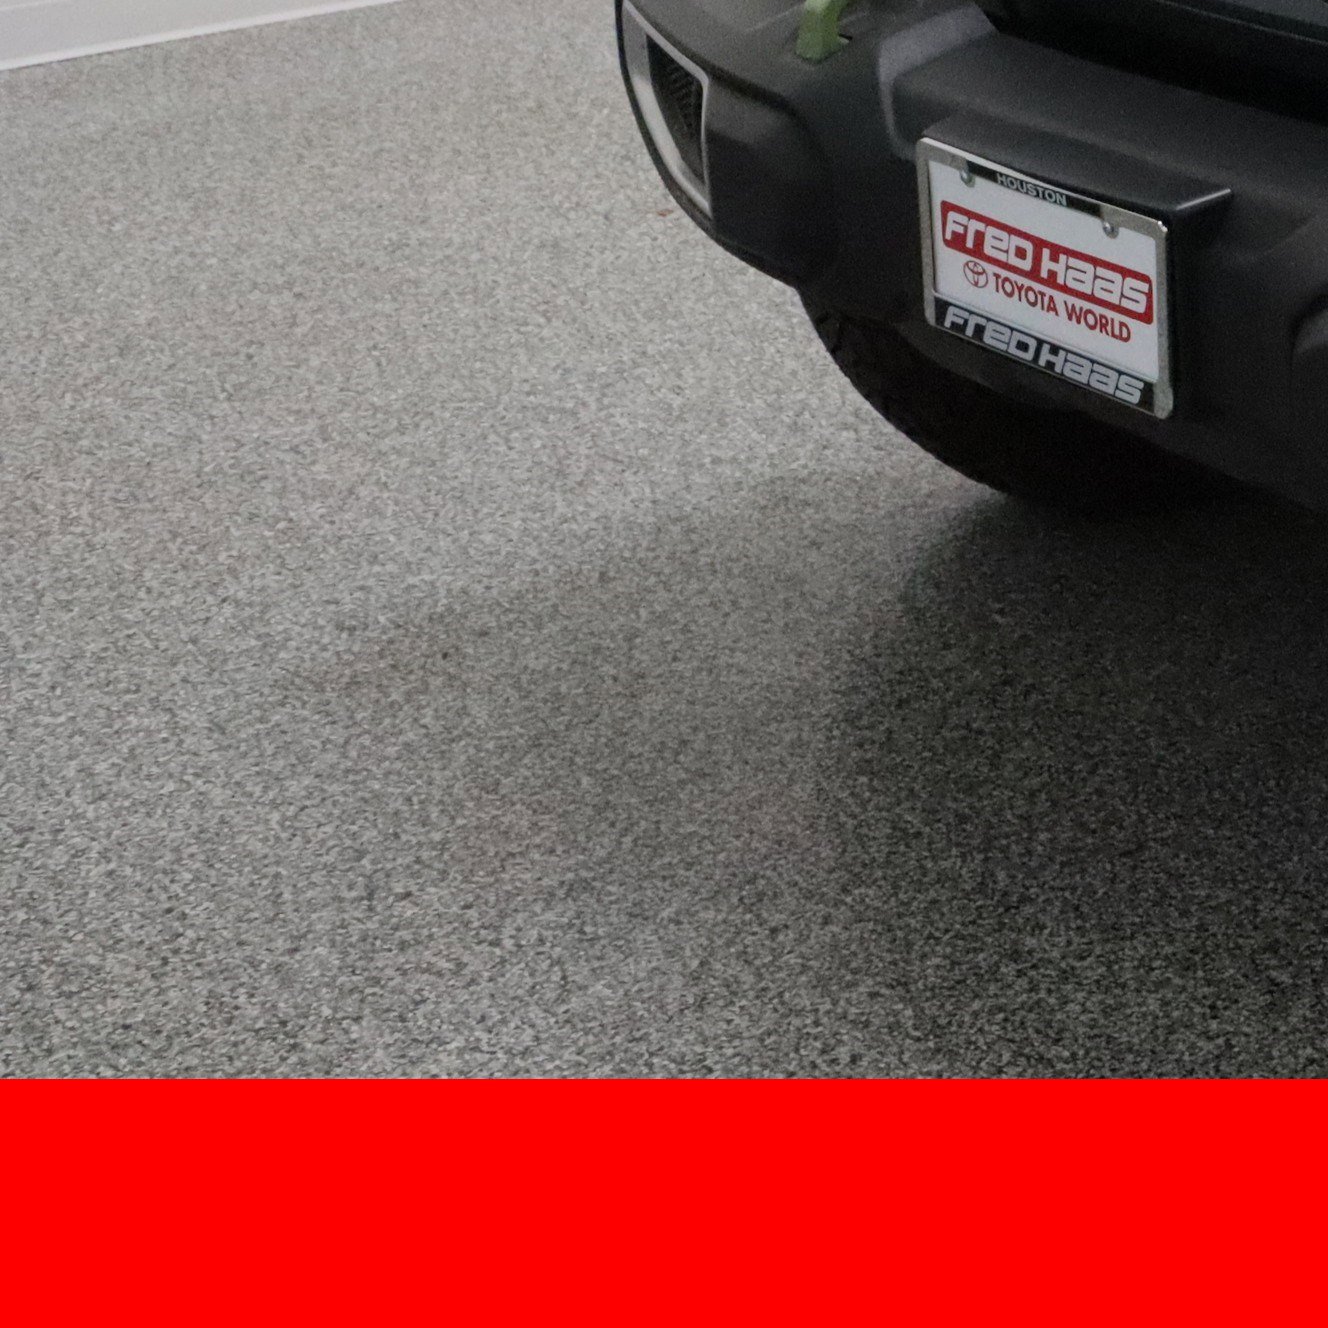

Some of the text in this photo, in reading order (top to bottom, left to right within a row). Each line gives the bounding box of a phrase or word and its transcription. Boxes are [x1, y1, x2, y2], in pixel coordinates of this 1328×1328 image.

[996, 172, 1068, 207] HOUSTON
[992, 272, 1132, 344] TOYOTA WORLD
